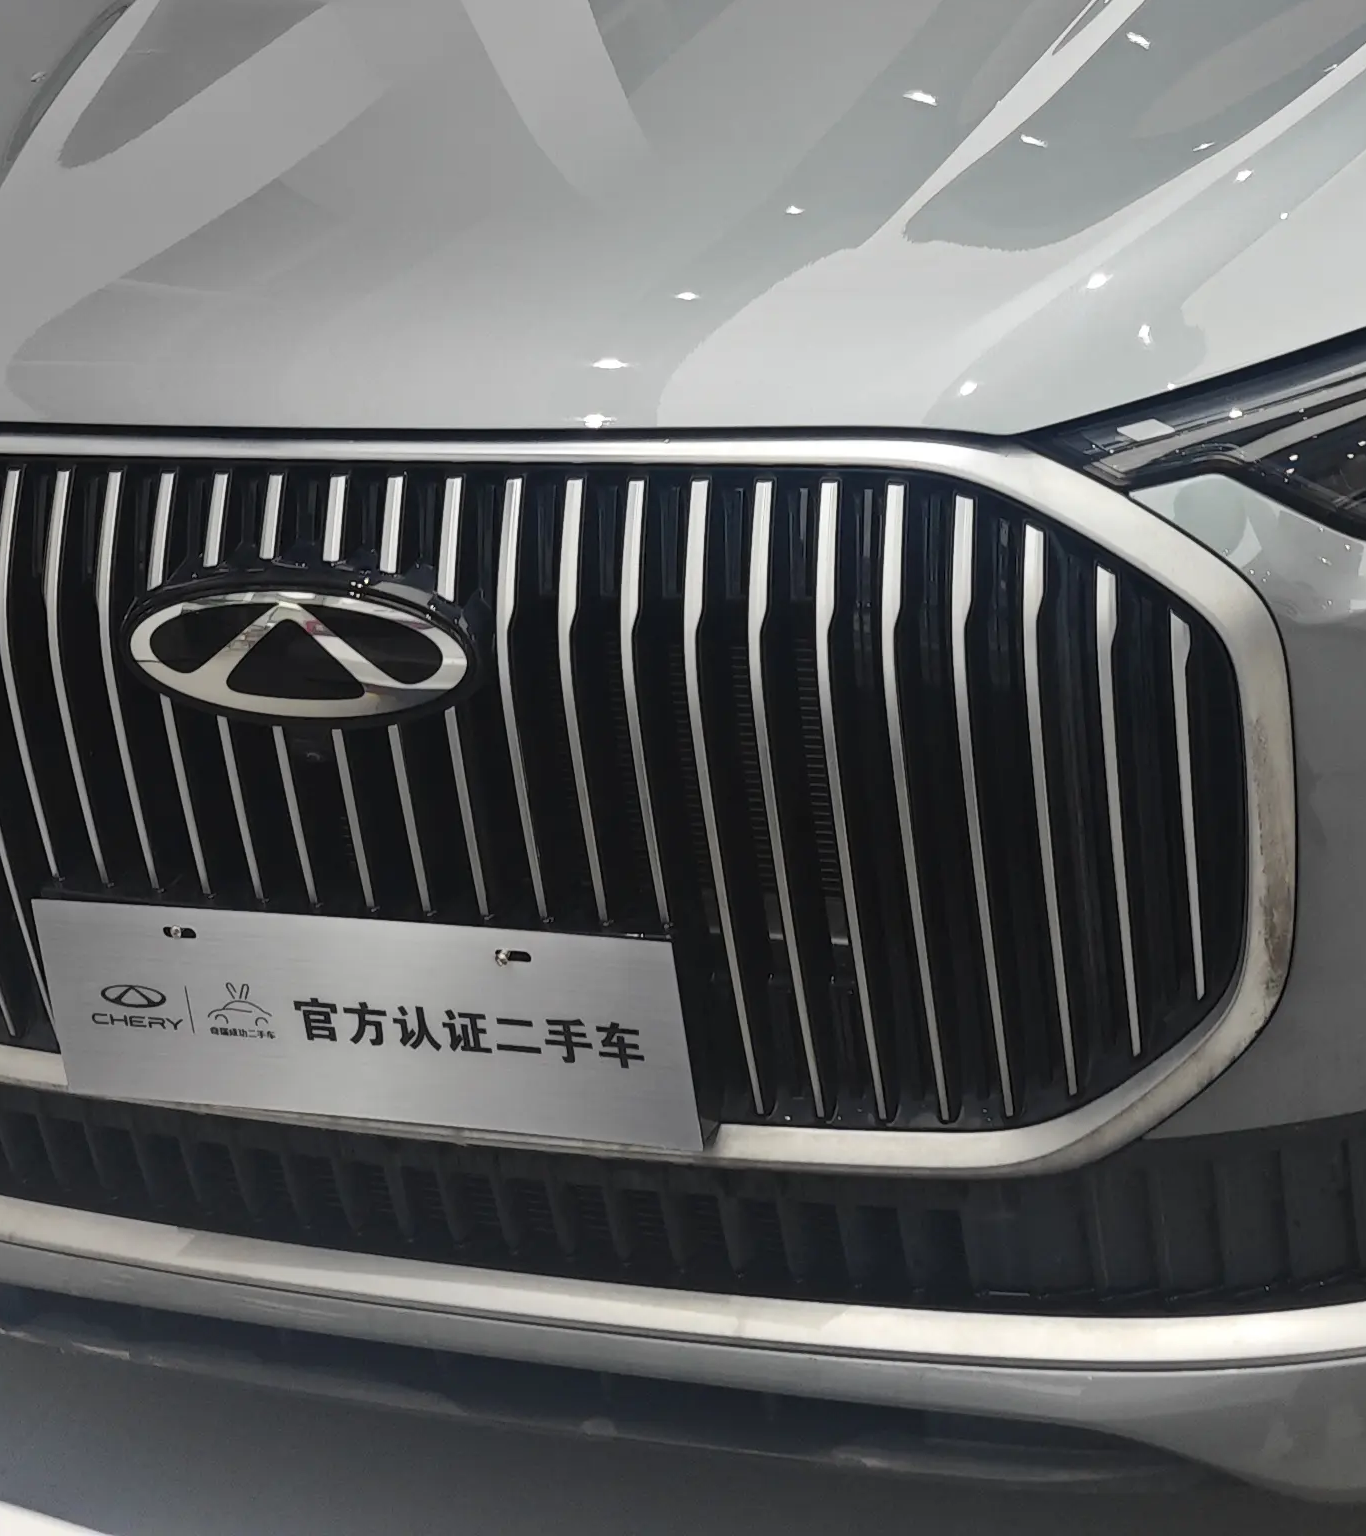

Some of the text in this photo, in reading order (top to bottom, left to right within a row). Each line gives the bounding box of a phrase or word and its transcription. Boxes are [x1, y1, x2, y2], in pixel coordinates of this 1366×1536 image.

[92, 1013, 183, 1030] CHERY
[293, 997, 645, 1068] 官方认证二手车
